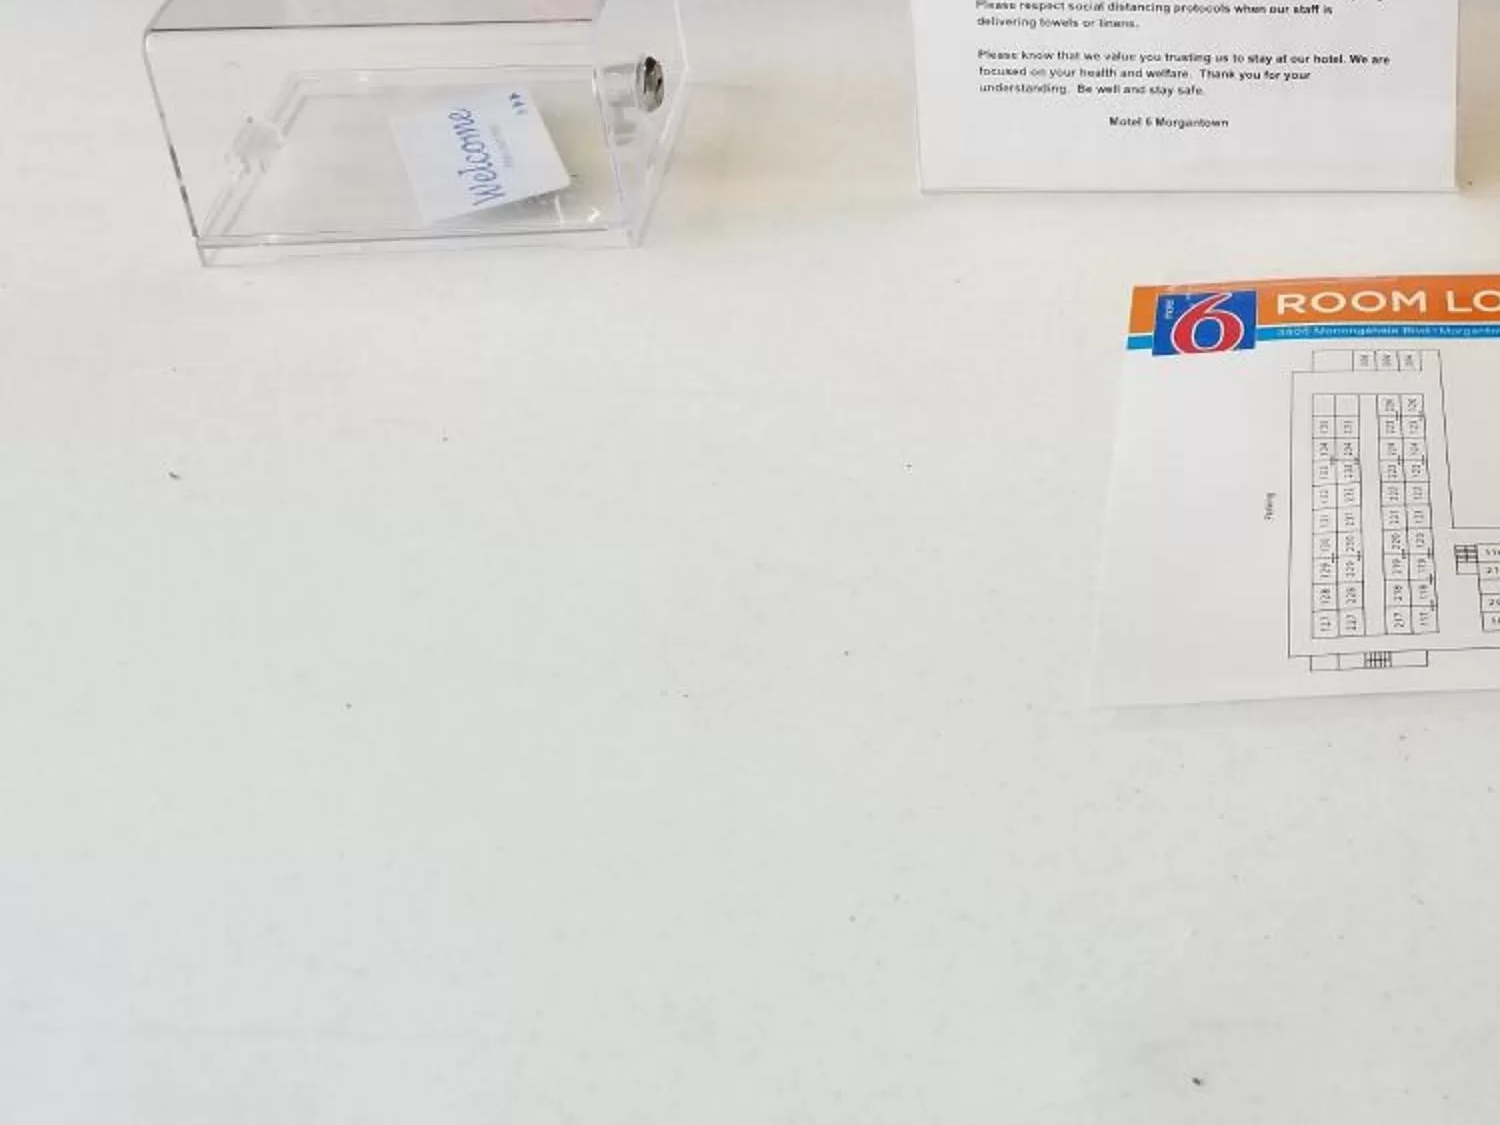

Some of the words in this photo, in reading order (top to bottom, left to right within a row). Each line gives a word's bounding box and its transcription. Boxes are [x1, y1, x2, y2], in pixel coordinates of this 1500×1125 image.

[978, 50, 1017, 59] Please
[1022, 51, 1054, 59] know
[1057, 51, 1079, 59] that
[1106, 52, 1136, 61] value
[1140, 55, 1161, 63] you
[1165, 53, 1211, 64] trusting
[1233, 54, 1244, 63] to
[1248, 55, 1272, 65] stay
[1276, 54, 1287, 63] at
[1314, 55, 1345, 63] hotel.
[1349, 55, 1368, 63] We
[1109, 117, 1141, 125] Motel
[1156, 117, 1228, 129] Morgantown
[448, 108, 505, 206] Welcome
[1276, 290, 1427, 316] ROOM
[1170, 291, 1245, 355] 6
